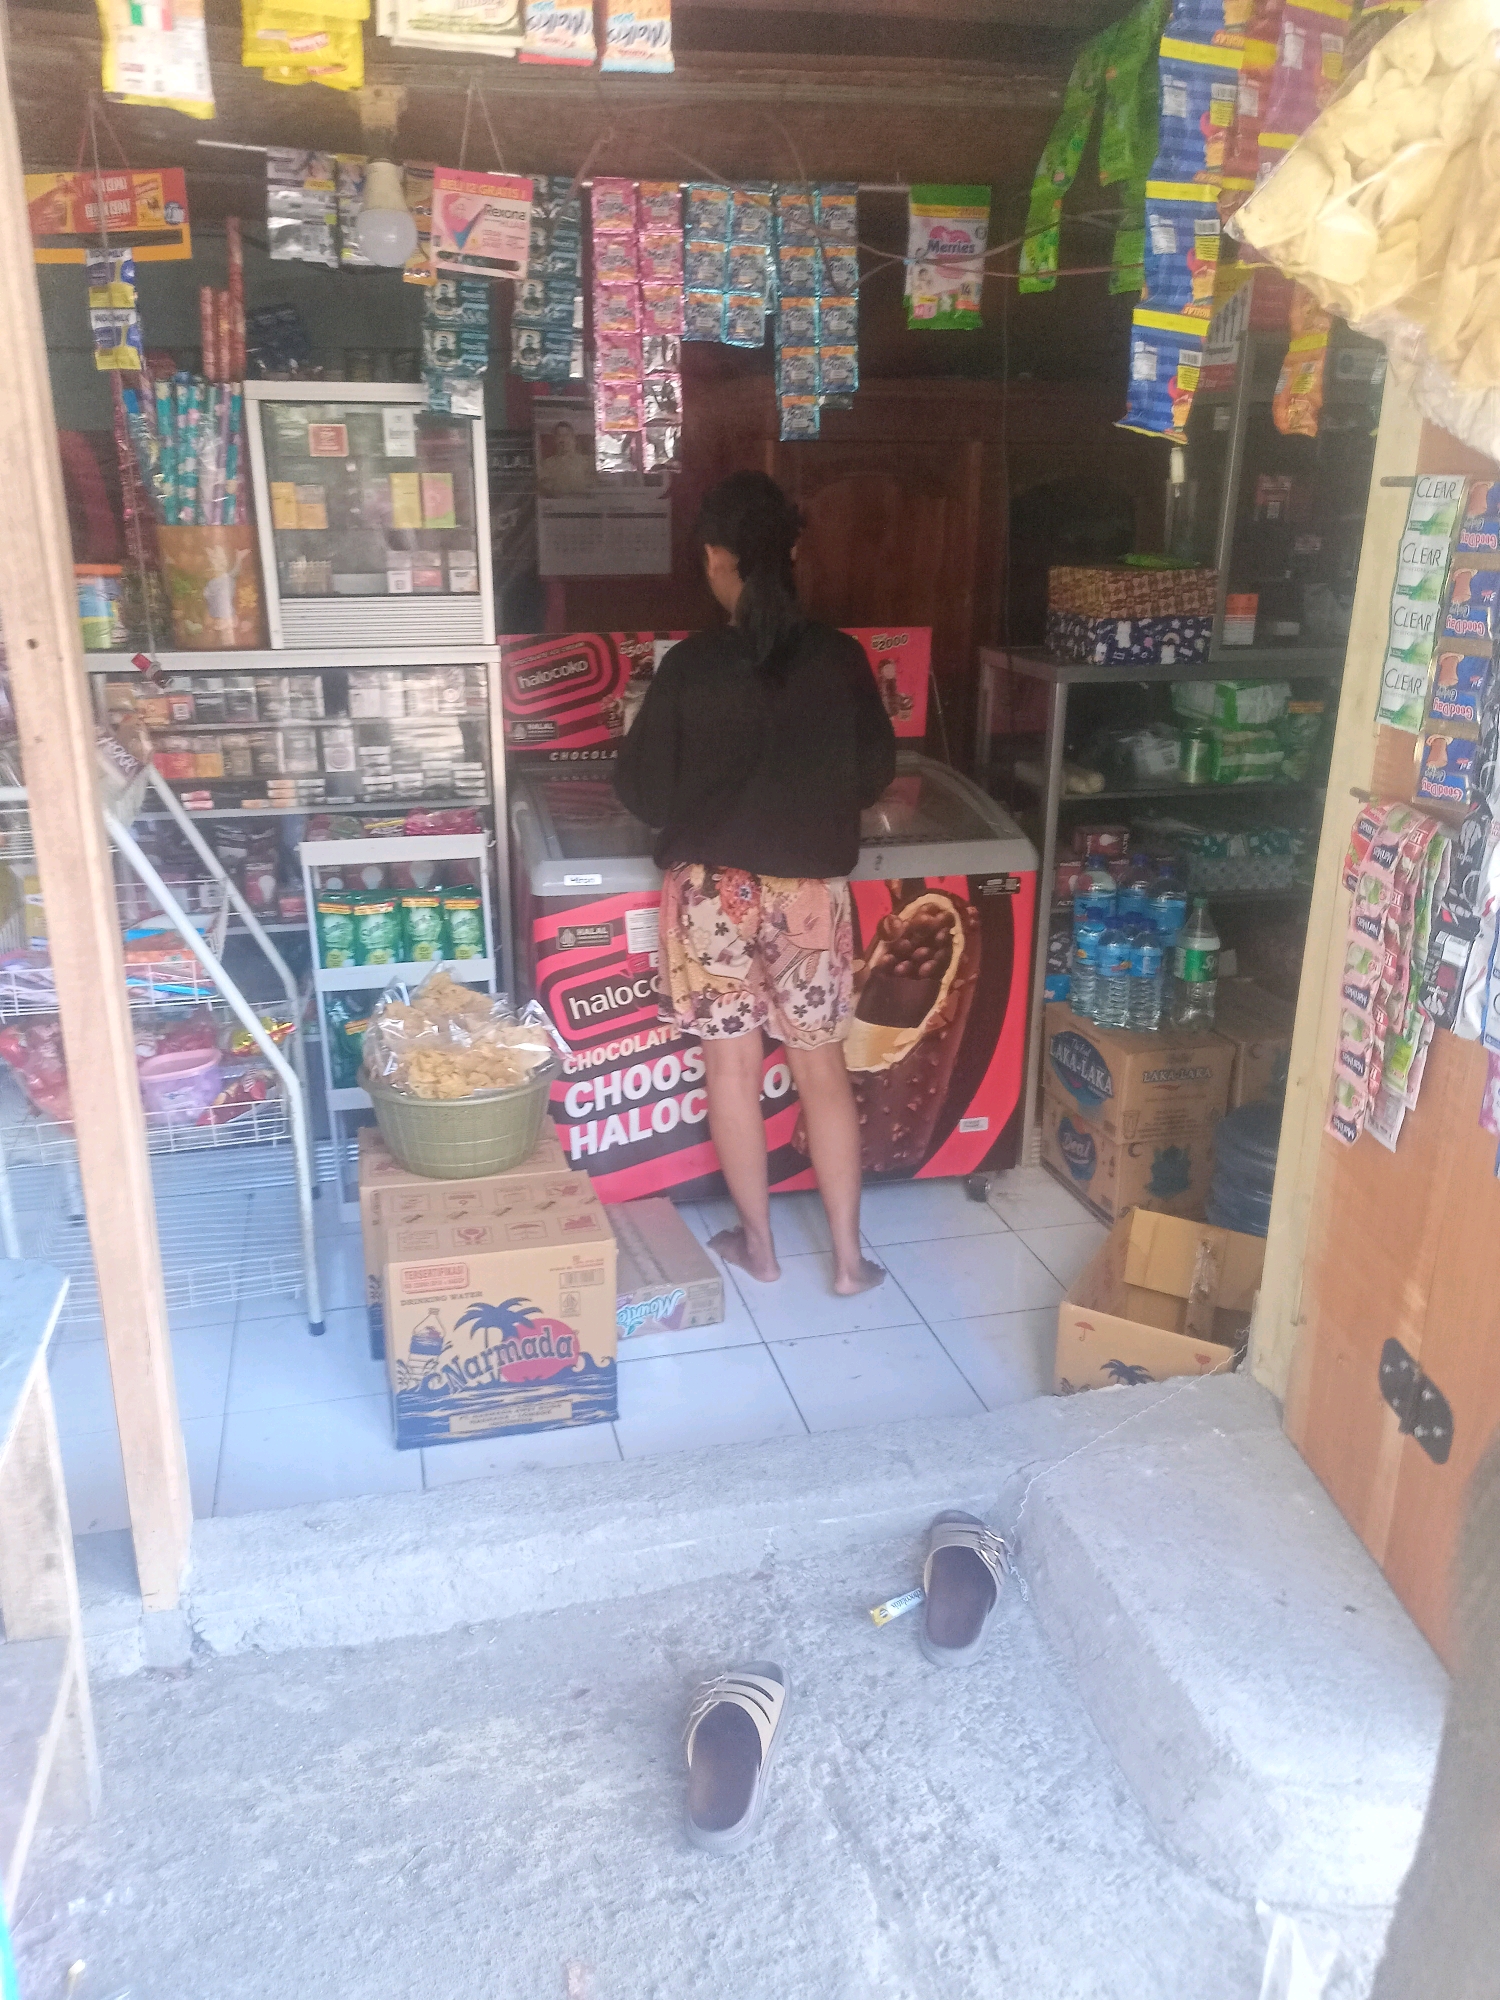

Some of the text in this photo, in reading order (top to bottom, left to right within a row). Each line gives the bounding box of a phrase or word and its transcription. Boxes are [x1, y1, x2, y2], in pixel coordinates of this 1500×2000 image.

[484, 203, 525, 221] Rexona
[928, 240, 975, 254] Merries
[1417, 477, 1457, 500] CLEAR
[1402, 542, 1442, 566] CLEAR
[1394, 606, 1433, 633] CLEAR
[878, 634, 909, 651] 2000
[517, 660, 589, 689] halocoko
[1384, 667, 1423, 694] CLEAR
[576, 926, 609, 936] HALAL
[562, 1023, 682, 1075] CHOCOLATE
[1049, 1037, 1113, 1098] LAKA-LAKA
[1143, 1068, 1212, 1083] LAKA-LAKA
[400, 1291, 483, 1307] DRINKING WATER
[442, 1326, 575, 1394] Narmada
